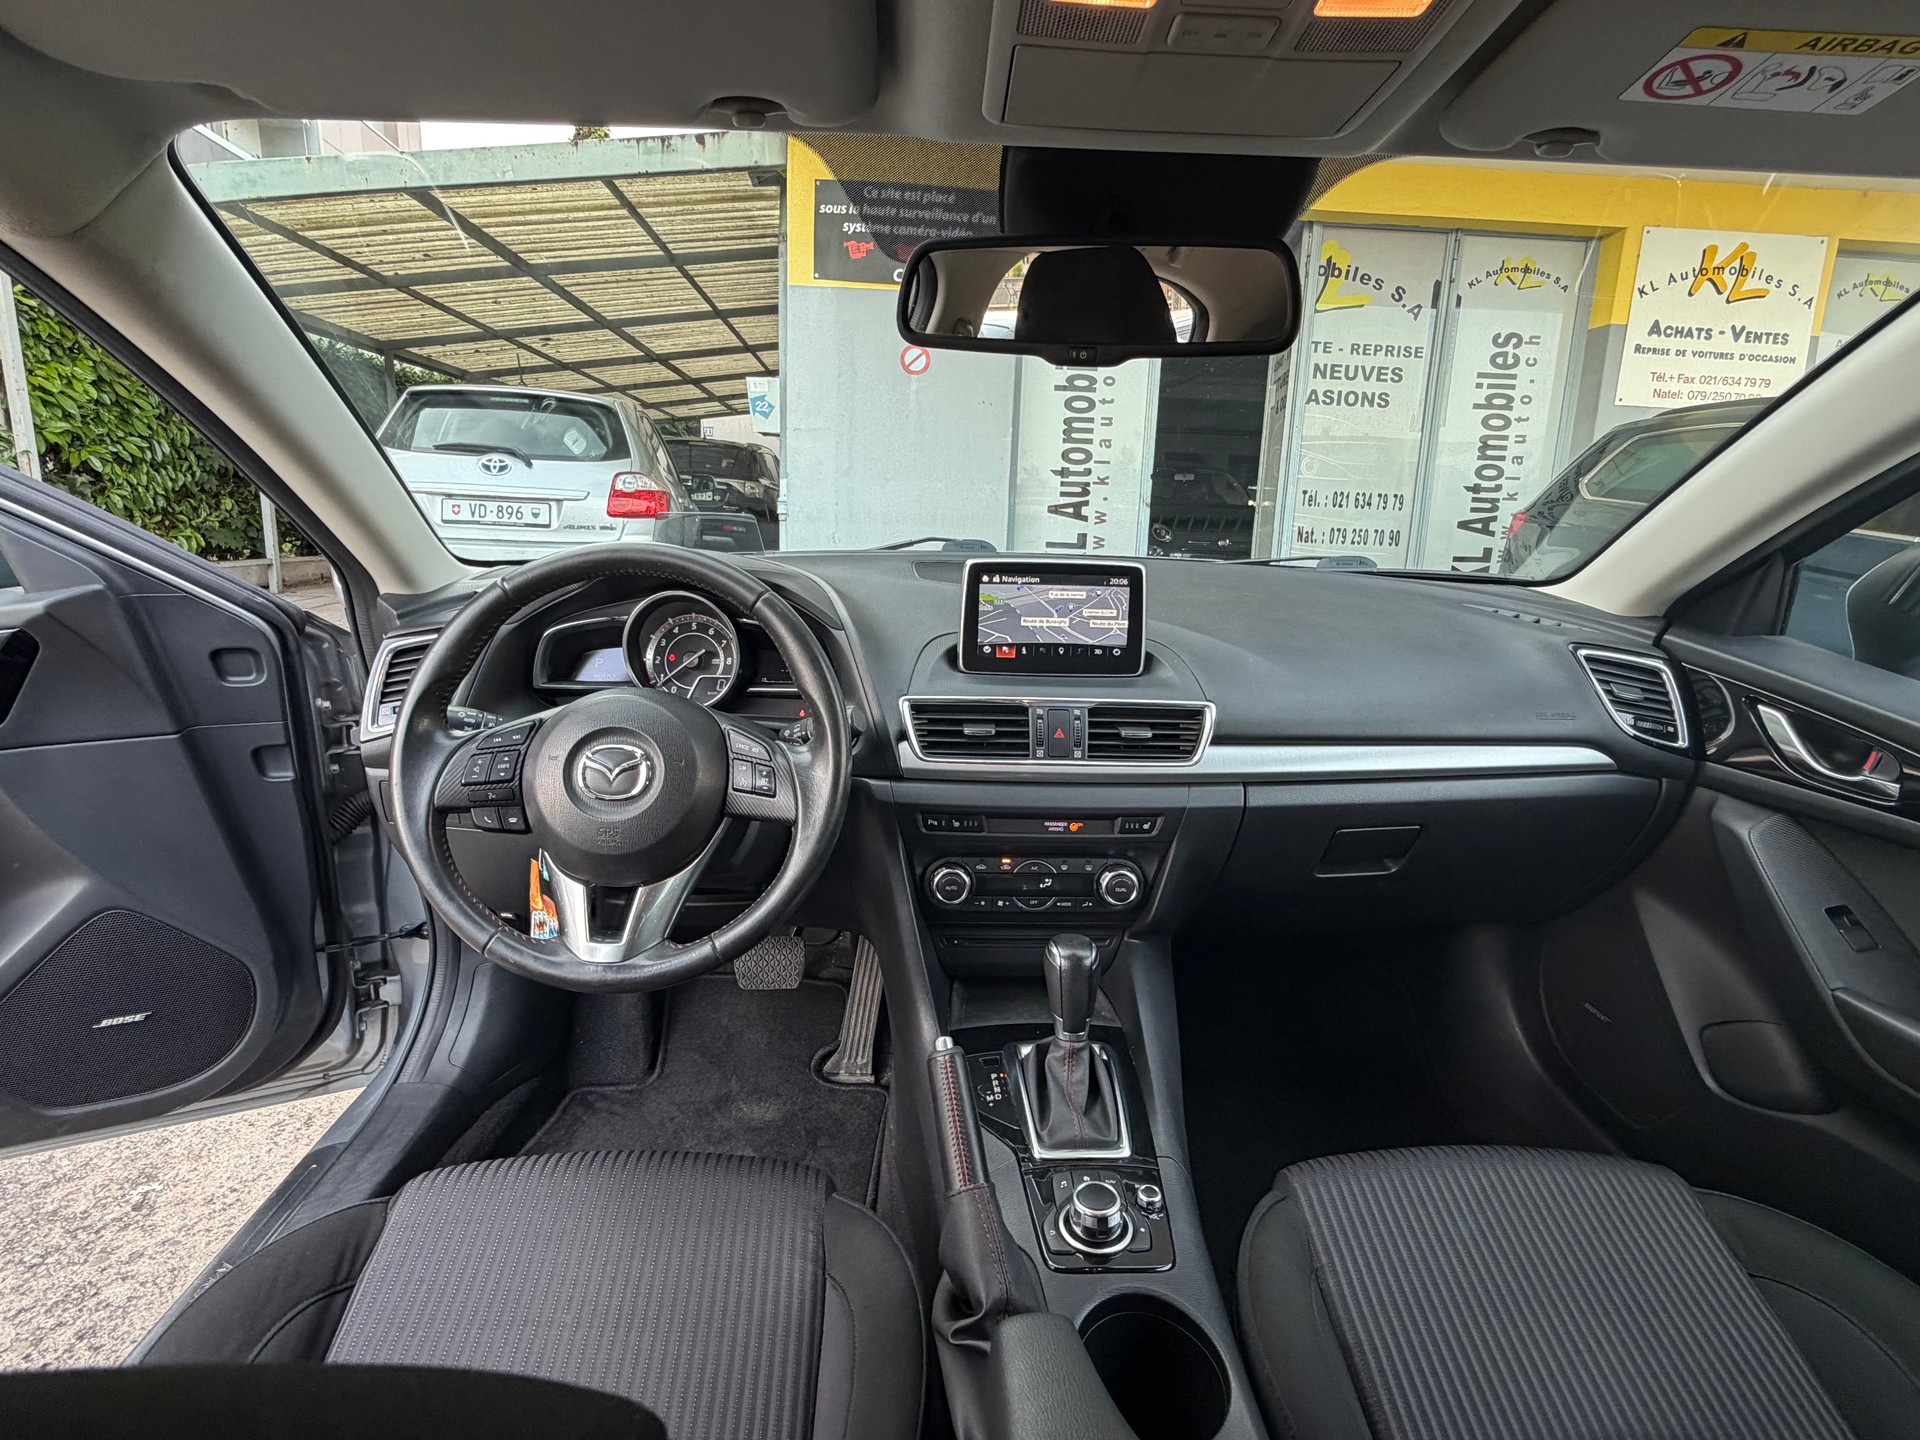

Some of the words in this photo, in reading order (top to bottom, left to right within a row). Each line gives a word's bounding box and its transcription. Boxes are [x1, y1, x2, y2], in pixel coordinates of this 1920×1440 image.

[1795, 36, 1920, 55] AIRBAG
[819, 204, 847, 214] sous
[849, 203, 861, 215] la
[1467, 277, 1483, 290] KL
[1485, 265, 1552, 280] Automobiles
[1688, 241, 1770, 305] KL
[1637, 280, 1660, 299] KL
[1667, 264, 1784, 289] Automobiles
[1788, 284, 1815, 310] S.A
[1836, 288, 1850, 300] KL
[1852, 278, 1911, 294] Automobiles
[1349, 342, 1425, 359] REPRISE
[1312, 362, 1404, 384] NEUVES
[1677, 373, 1696, 385] Fax
[1699, 375, 1742, 387] 021/634
[1744, 377, 1757, 388] 79
[1758, 378, 1771, 389] 79
[1305, 388, 1391, 409] ASIONS
[1652, 388, 1684, 400] Natel:
[755, 401, 769, 412] 22
[1456, 331, 1524, 538] Automobiles
[1047, 366, 1098, 523] Automobi
[1302, 490, 1321, 508] Tél.
[1332, 491, 1350, 509] 021
[1354, 492, 1373, 510] 634
[1376, 493, 1389, 511] 79
[1393, 493, 1405, 512] 79
[1296, 526, 1318, 544] Nat.
[1329, 527, 1348, 545] 079
[1350, 528, 1369, 546] 250
[1372, 529, 1385, 546] 70
[1388, 530, 1401, 547] 90
[1002, 575, 1040, 585] Navigation
[1109, 578, 1128, 586] 20:06
[673, 626, 679, 634] 4
[691, 622, 697, 630] 5
[708, 627, 715, 635] 6
[660, 638, 666, 646] 3
[721, 640, 727, 648] 7
[655, 656, 661, 664] 2
[726, 657, 732, 665] 8
[659, 673, 664, 681] 1
[670, 685, 677, 694] 0
